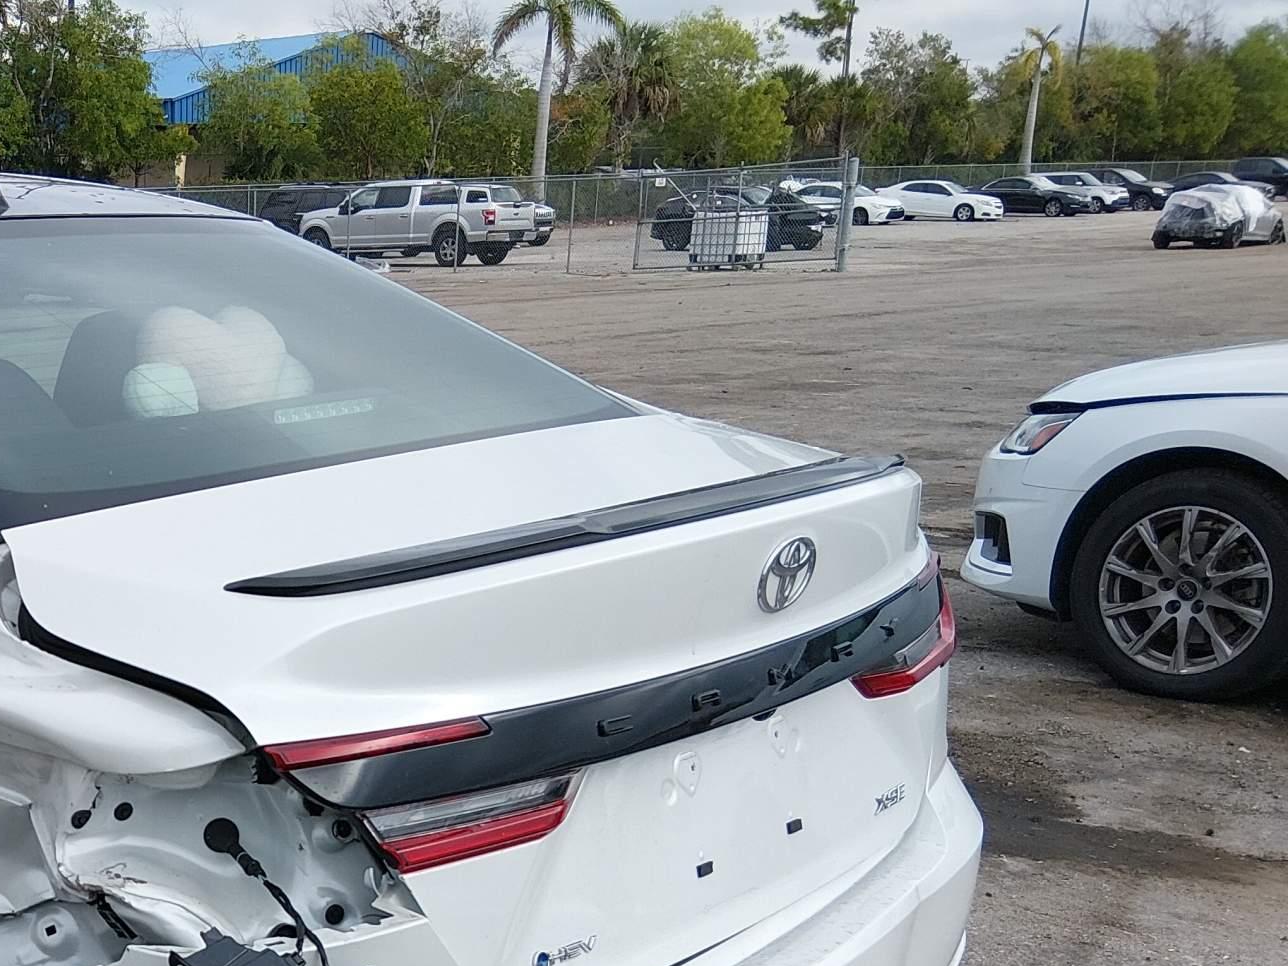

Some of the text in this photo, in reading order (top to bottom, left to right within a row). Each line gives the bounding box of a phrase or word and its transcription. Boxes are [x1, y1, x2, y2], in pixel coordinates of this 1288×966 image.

[596, 616, 899, 738] CAMRY
[874, 782, 905, 816] XSE
[548, 934, 597, 966] HEV
